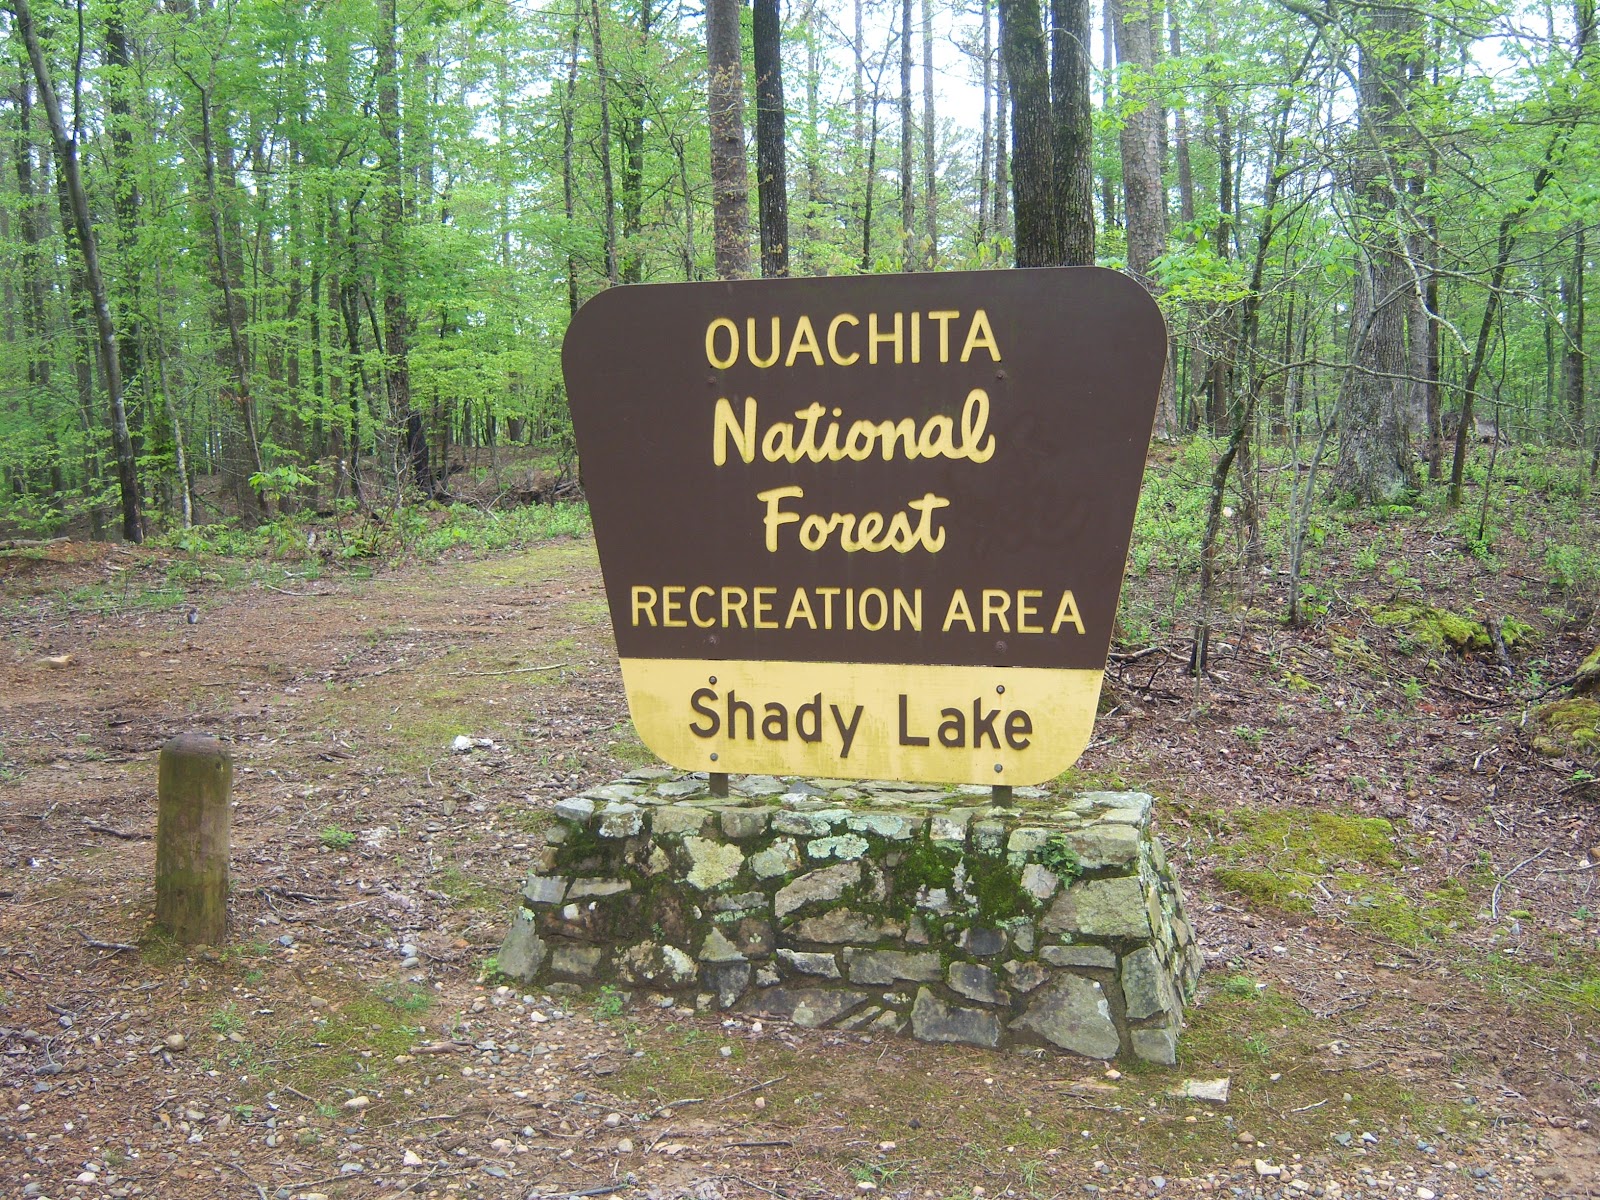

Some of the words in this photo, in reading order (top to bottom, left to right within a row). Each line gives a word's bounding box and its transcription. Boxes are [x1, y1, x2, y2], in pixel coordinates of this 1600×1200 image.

[705, 309, 1003, 370] OUACHITA
[713, 388, 996, 467] National
[756, 485, 951, 554] Forest
[631, 585, 922, 632] RECREATION
[942, 588, 1086, 637] AREA
[689, 687, 864, 759] Shady
[898, 694, 1033, 751] Lake
